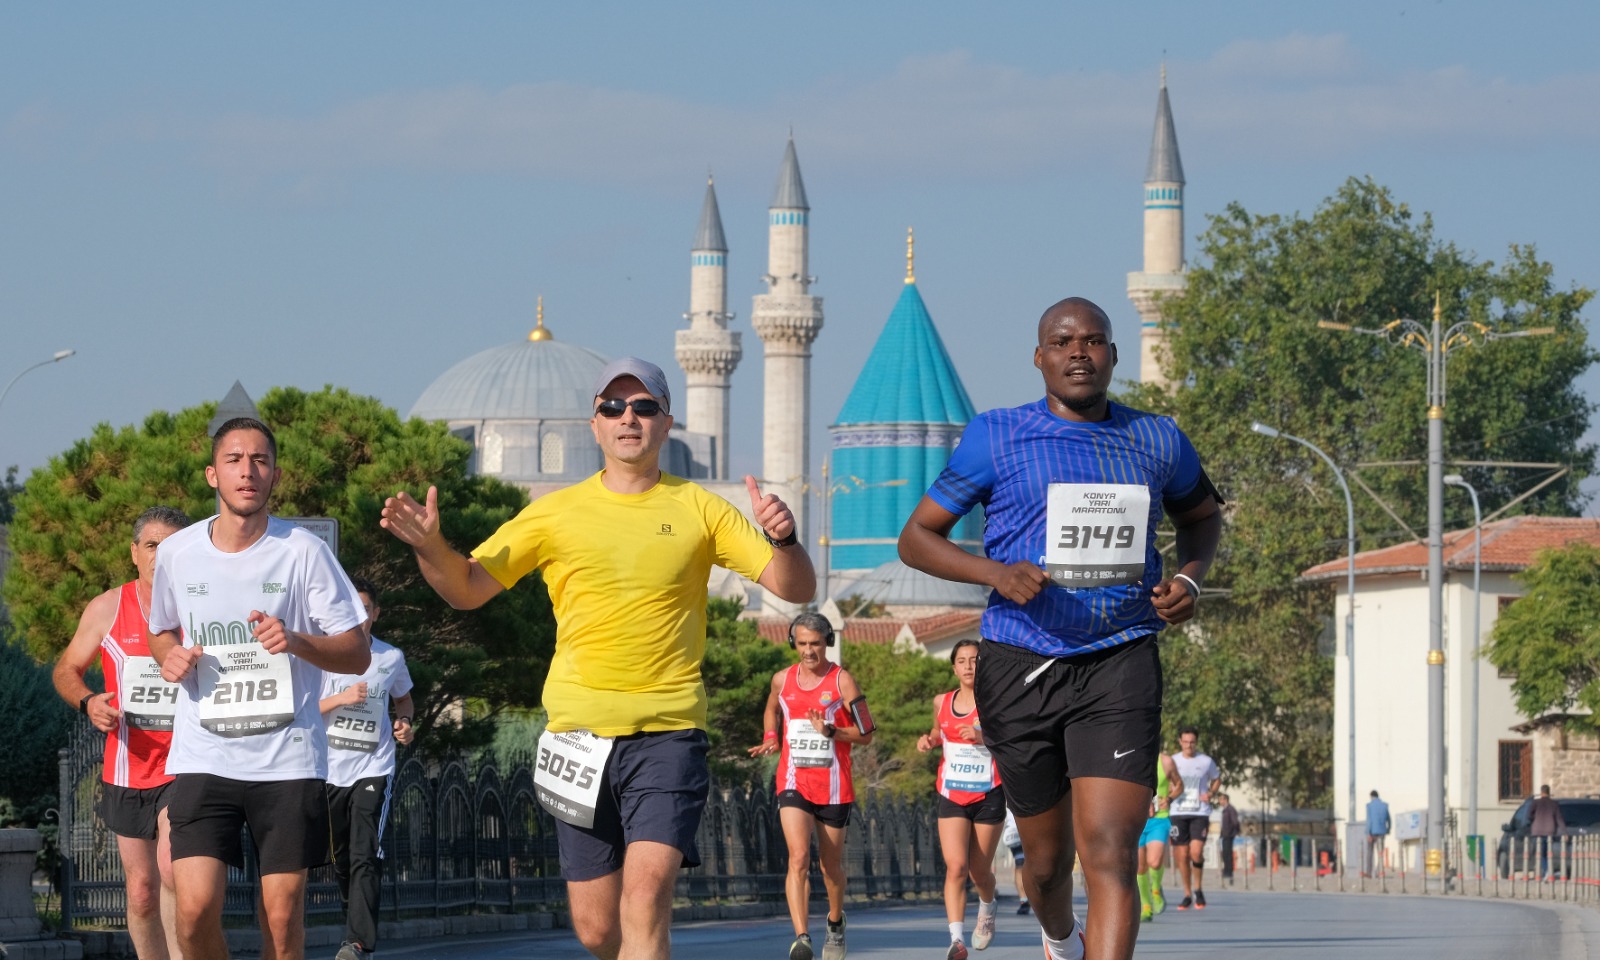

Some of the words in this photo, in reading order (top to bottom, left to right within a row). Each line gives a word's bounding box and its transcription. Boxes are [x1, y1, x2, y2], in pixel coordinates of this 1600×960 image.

[1083, 492, 1117, 500] KONYA
[1058, 525, 1136, 549] 3149
[228, 651, 257, 659] KONYA
[219, 663, 269, 672] MARATONU
[130, 686, 180, 704] 254
[214, 679, 278, 705] 2118
[333, 715, 377, 733] 2128
[553, 734, 592, 753] MARATONU
[564, 731, 582, 742] YARI
[790, 739, 830, 750] 2568
[537, 746, 599, 790] 3055
[950, 763, 985, 774] 47841
